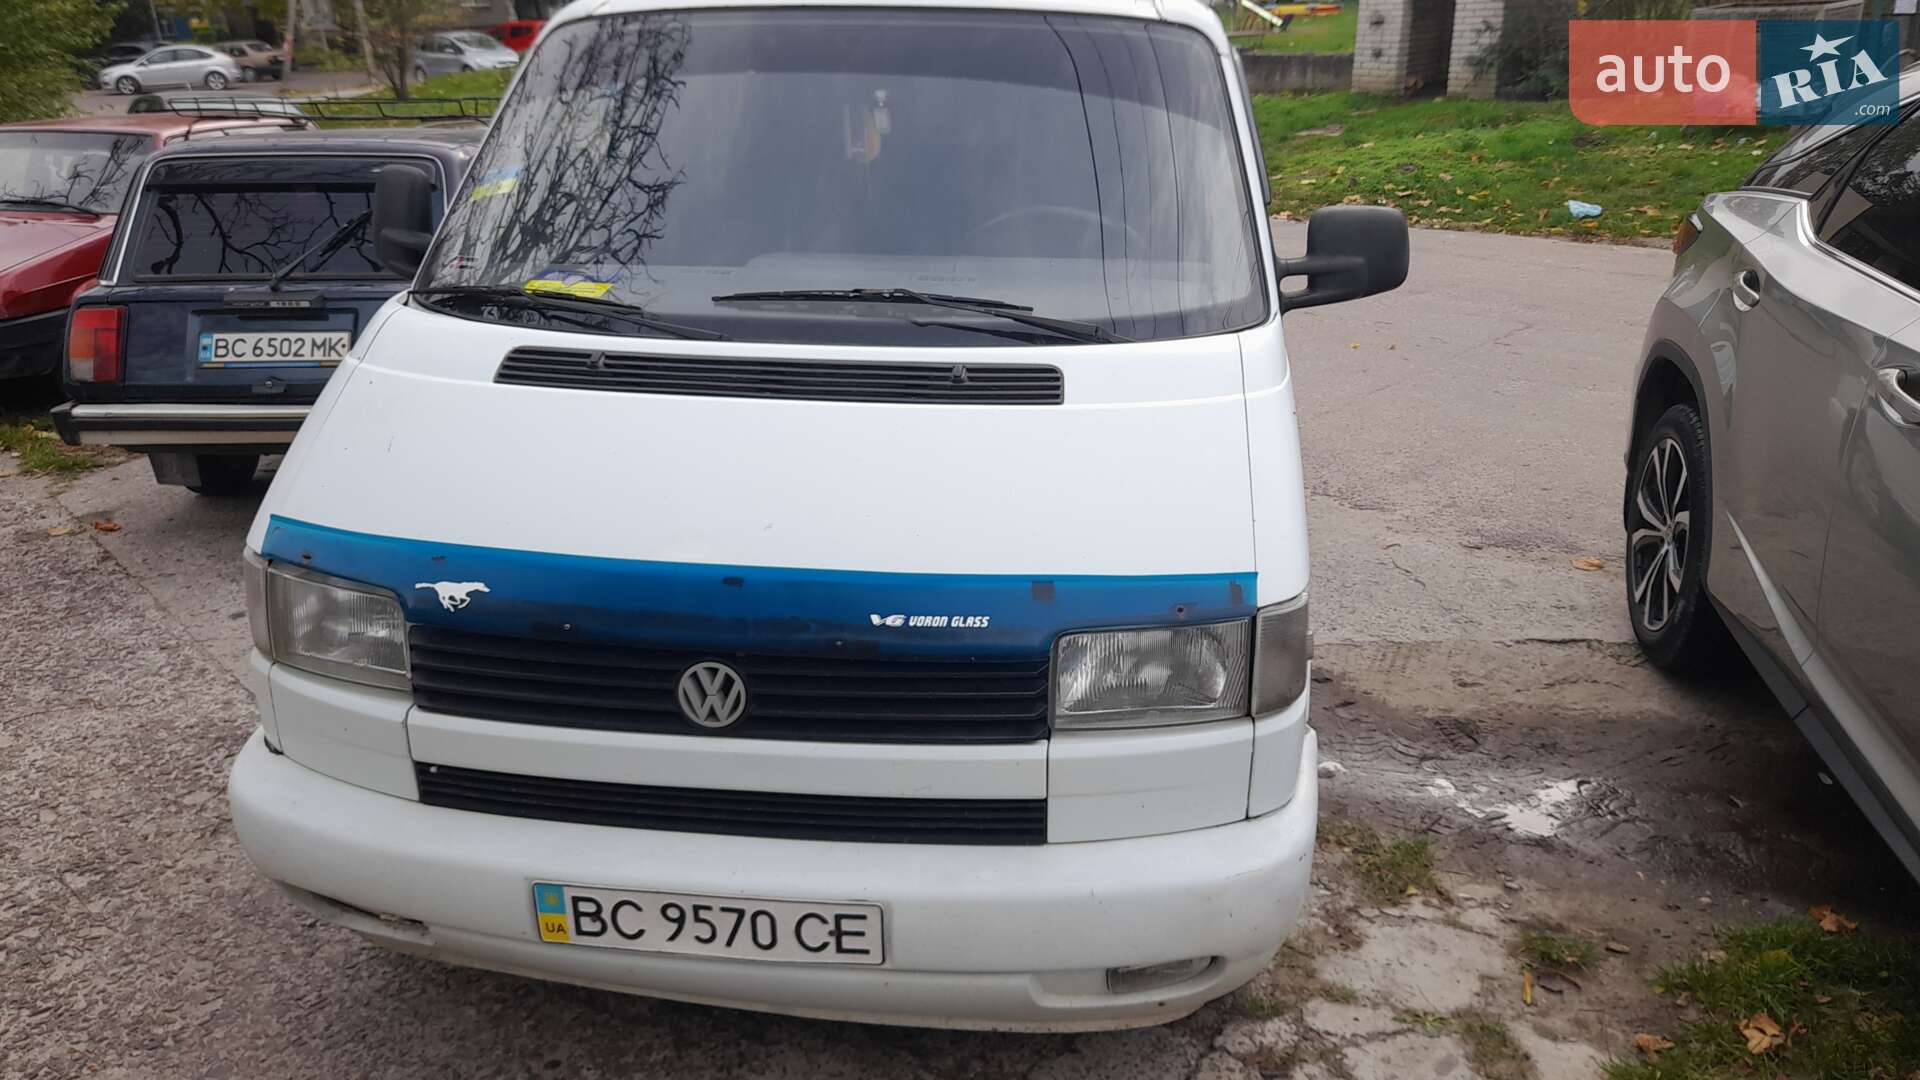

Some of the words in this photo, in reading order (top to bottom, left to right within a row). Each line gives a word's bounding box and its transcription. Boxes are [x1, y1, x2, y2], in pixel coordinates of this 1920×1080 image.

[214, 338, 247, 358] BC
[252, 337, 306, 358] 6502
[310, 337, 344, 357] MK
[909, 616, 949, 628] VORON
[951, 616, 990, 628] GLASS
[545, 922, 567, 935] UA
[571, 895, 647, 941] BC
[660, 902, 778, 951] 9570
[794, 912, 871, 955] CE
